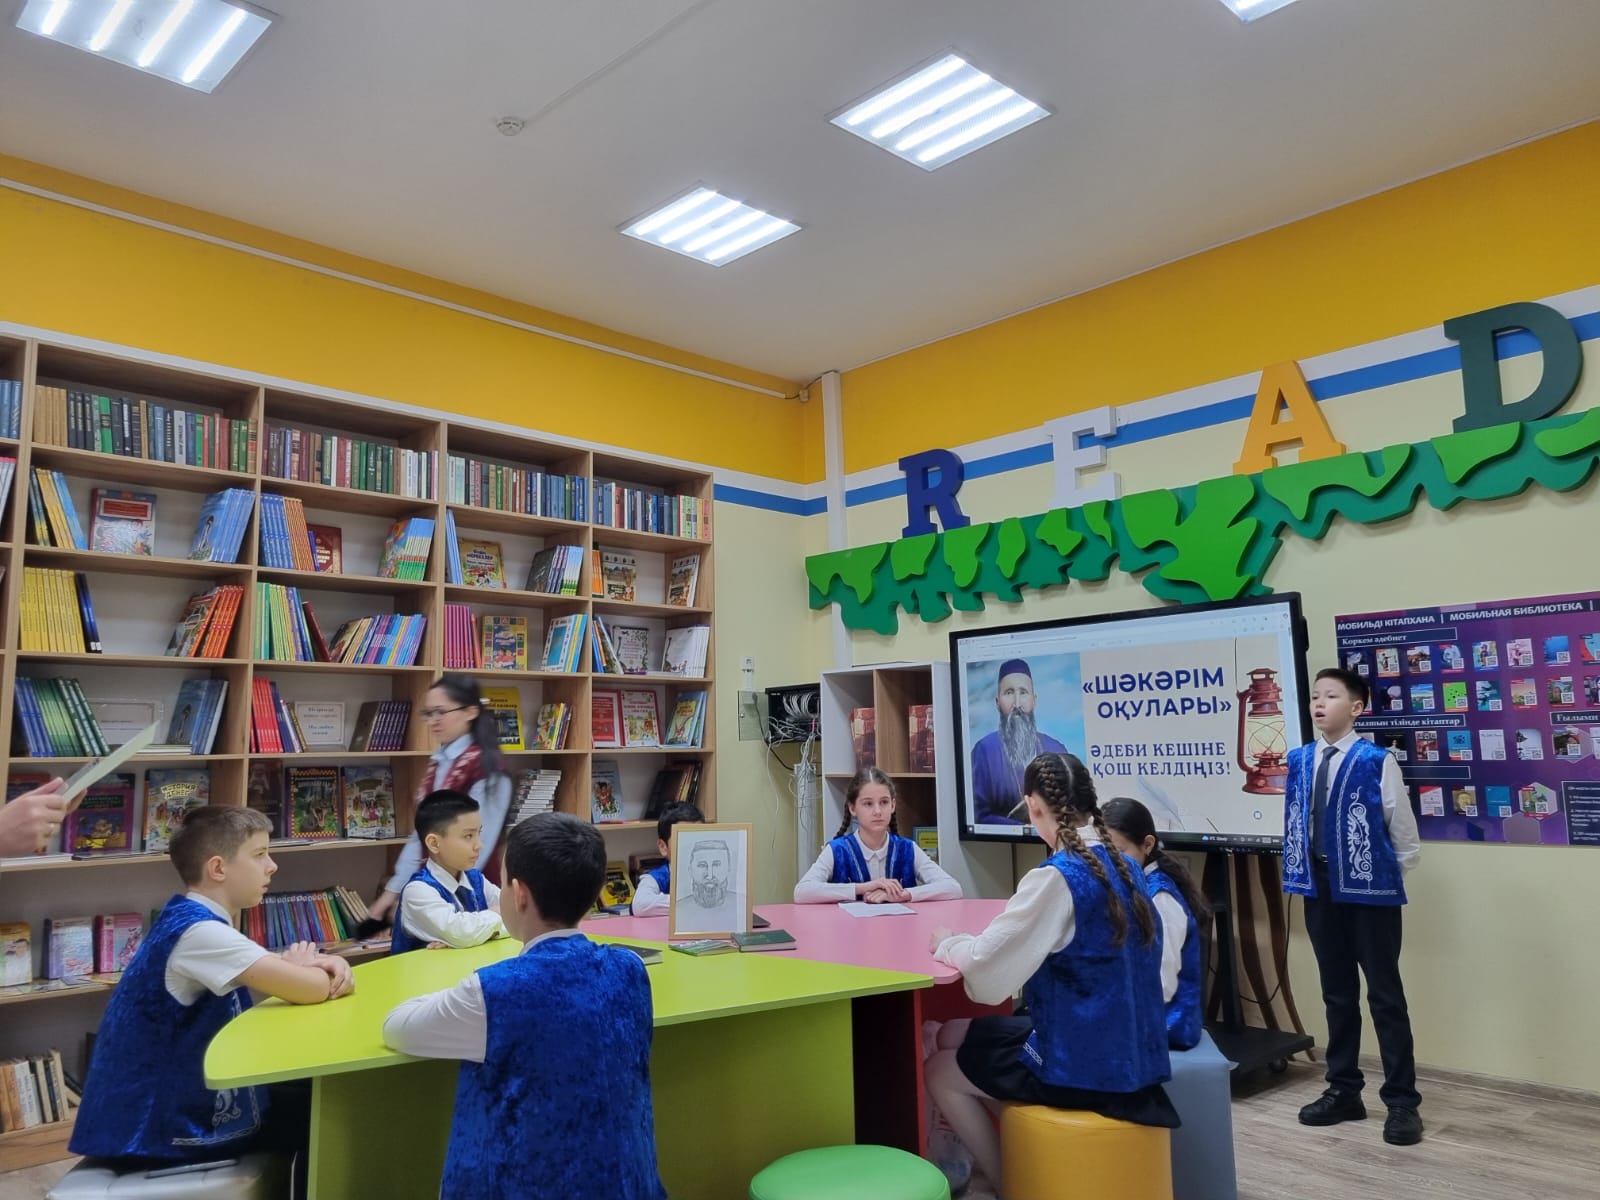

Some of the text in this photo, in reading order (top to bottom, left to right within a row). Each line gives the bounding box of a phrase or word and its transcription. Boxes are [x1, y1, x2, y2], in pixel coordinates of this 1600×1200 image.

[899, 302, 1584, 537] READ
[1337, 602, 1584, 631] МОБИЛЬДІ КІТАПХАНА МОБИЛЬНАЯ БИБЛИОТЕКА
[1083, 667, 1224, 694] «ШӘКӘРІМ
[1097, 696, 1232, 720] ОҚУЛАРЫ»
[1421, 717, 1461, 727] кітаптар
[1090, 742, 1226, 759] ӘДЕБИ КЕШІНЕ
[1093, 761, 1231, 778] ҚОШ КЕЛДІҢІЗ!
